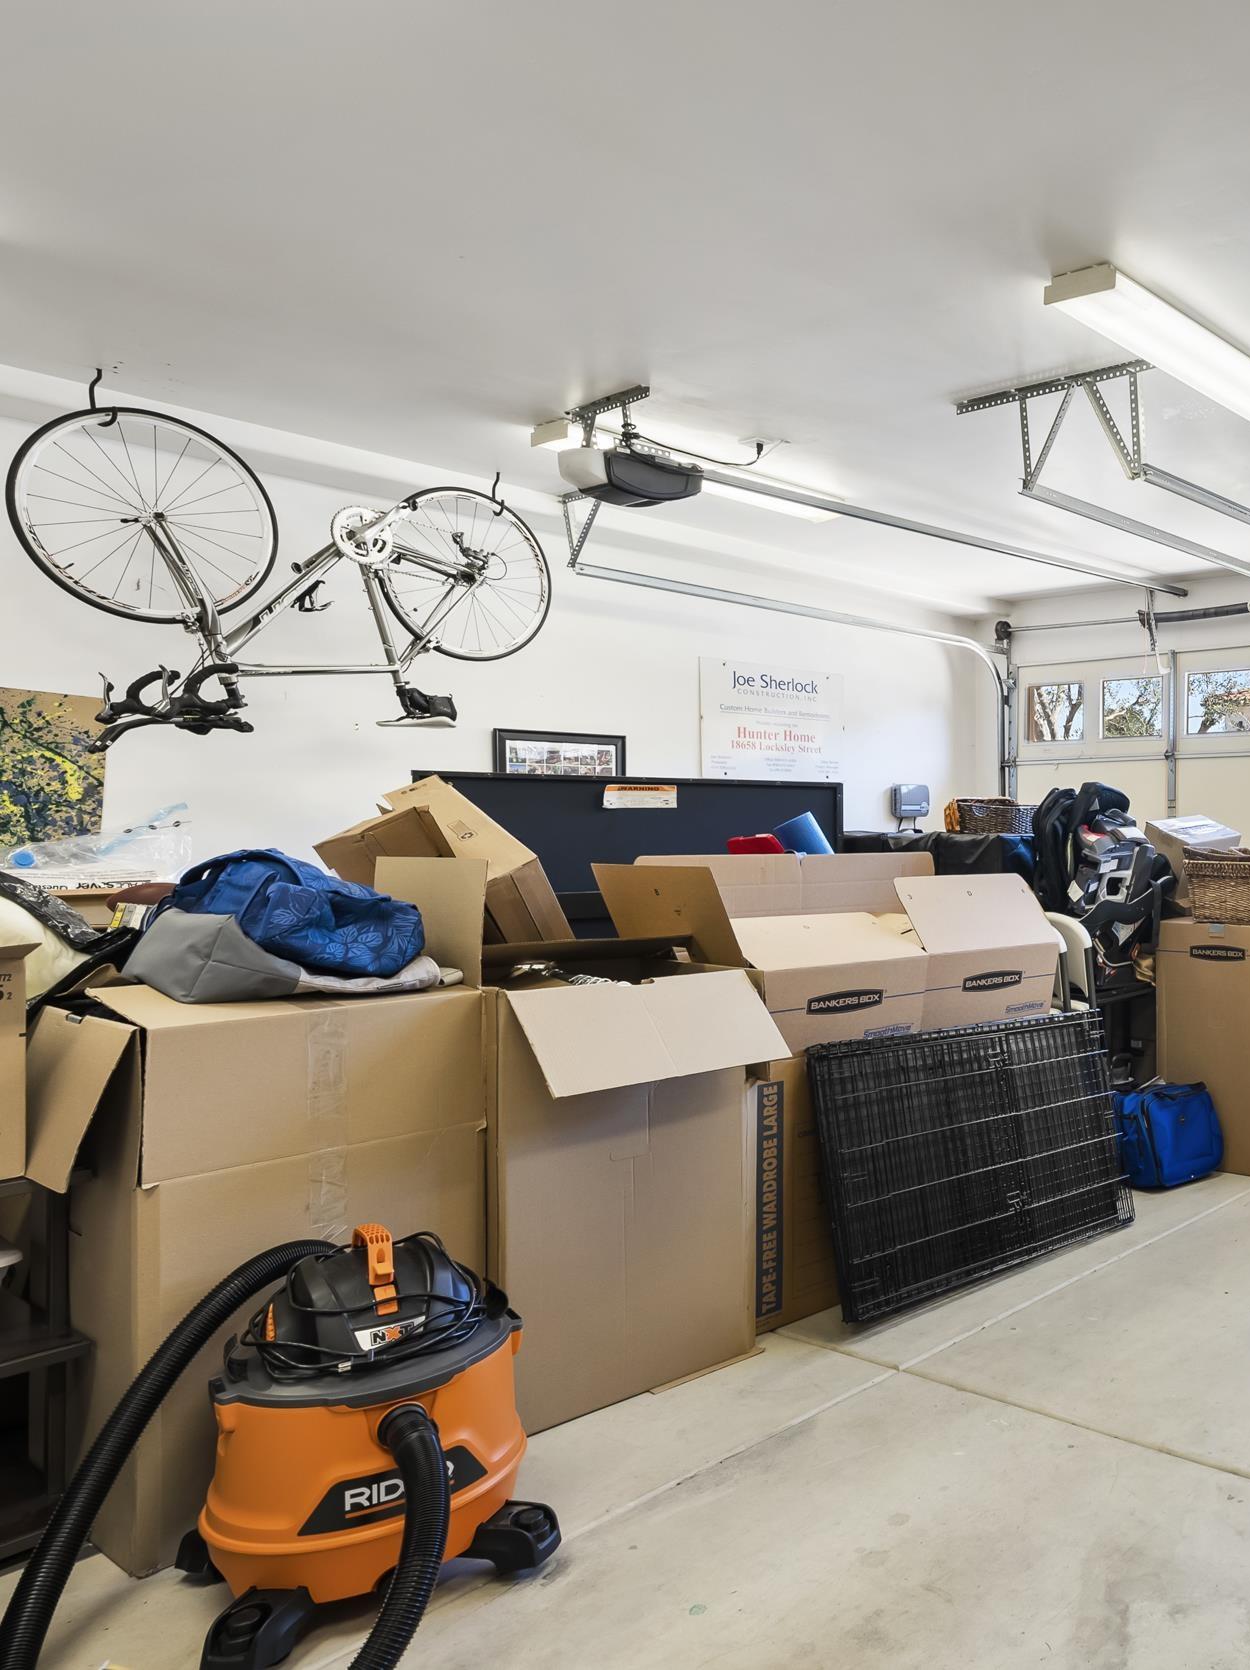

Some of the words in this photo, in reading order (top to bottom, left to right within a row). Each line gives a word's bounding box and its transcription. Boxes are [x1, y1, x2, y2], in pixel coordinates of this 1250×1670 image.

[732, 670, 756, 689] Joe
[760, 674, 818, 694] Sherlock
[720, 703, 743, 712] Custom
[736, 726, 780, 741] Hunter
[783, 729, 816, 743] Home
[731, 740, 757, 750] 18658
[759, 741, 796, 754] Locksley
[798, 745, 822, 754] Street
[1227, 950, 1243, 958] BOX
[965, 976, 1003, 988] BANKERS
[1003, 974, 1020, 983] BOX
[811, 996, 859, 1010] BANKERS
[860, 993, 880, 1003] BOX
[762, 1084, 778, 1136] LARGE
[762, 1138, 778, 1230] WARDROBE
[762, 1230, 777, 1314] TAPE-FREE
[370, 1321, 414, 1346] NXT
